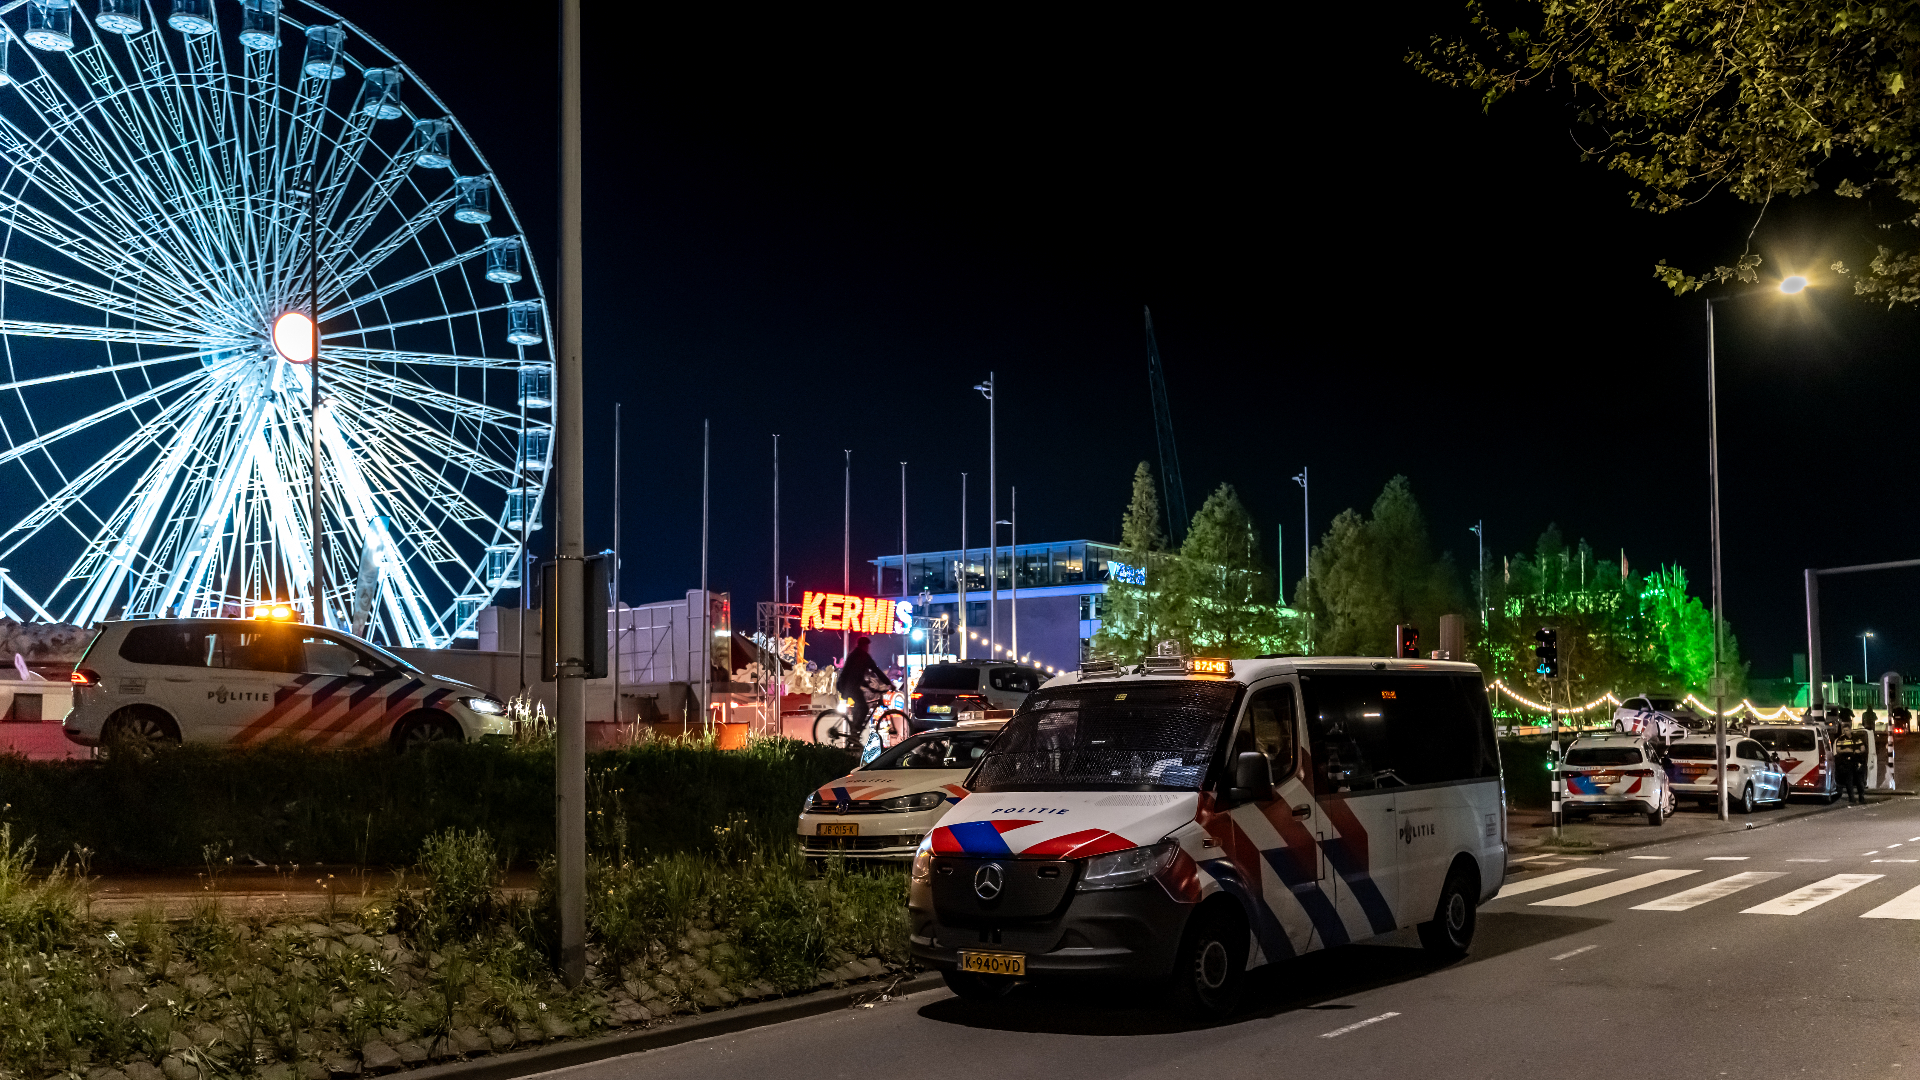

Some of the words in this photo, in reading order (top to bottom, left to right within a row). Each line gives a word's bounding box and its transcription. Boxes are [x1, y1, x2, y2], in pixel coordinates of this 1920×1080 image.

[800, 590, 914, 635] KERMIS
[207, 688, 269, 704] POLITIE
[991, 807, 1070, 815] POLITIE
[1399, 822, 1435, 844] POLITIE
[965, 955, 1020, 972] K-940-VD
